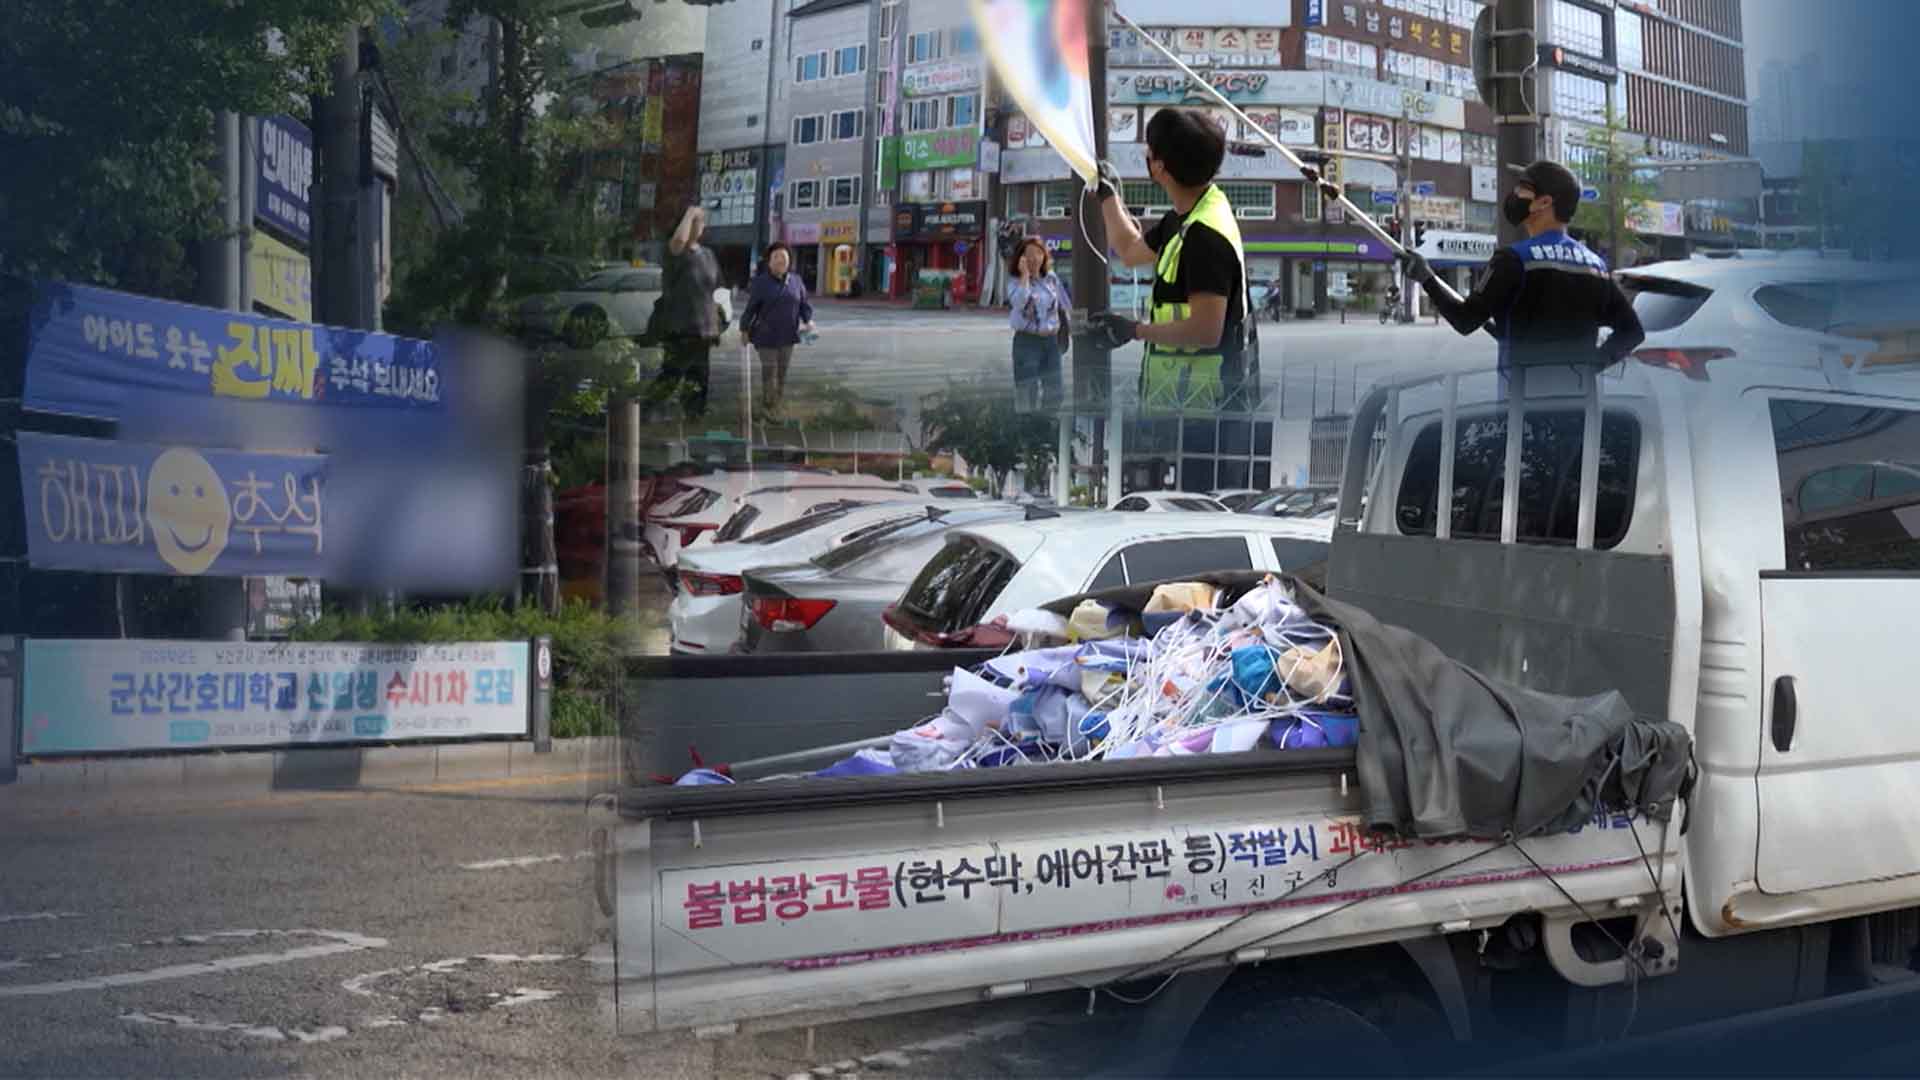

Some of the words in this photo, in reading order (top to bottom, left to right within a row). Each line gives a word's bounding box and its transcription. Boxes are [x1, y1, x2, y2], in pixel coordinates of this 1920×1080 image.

[84, 314, 158, 359] 아이도
[165, 327, 211, 374] 웃는
[212, 322, 320, 400] 진짜
[330, 357, 369, 393] 추석
[374, 361, 440, 402] 보내세요
[39, 459, 145, 546] 해피
[232, 471, 323, 555] 추석
[110, 671, 298, 715] 군산간호대학교
[307, 670, 378, 711] 신입생
[385, 669, 470, 709] 수시1차
[474, 668, 515, 705] 모집
